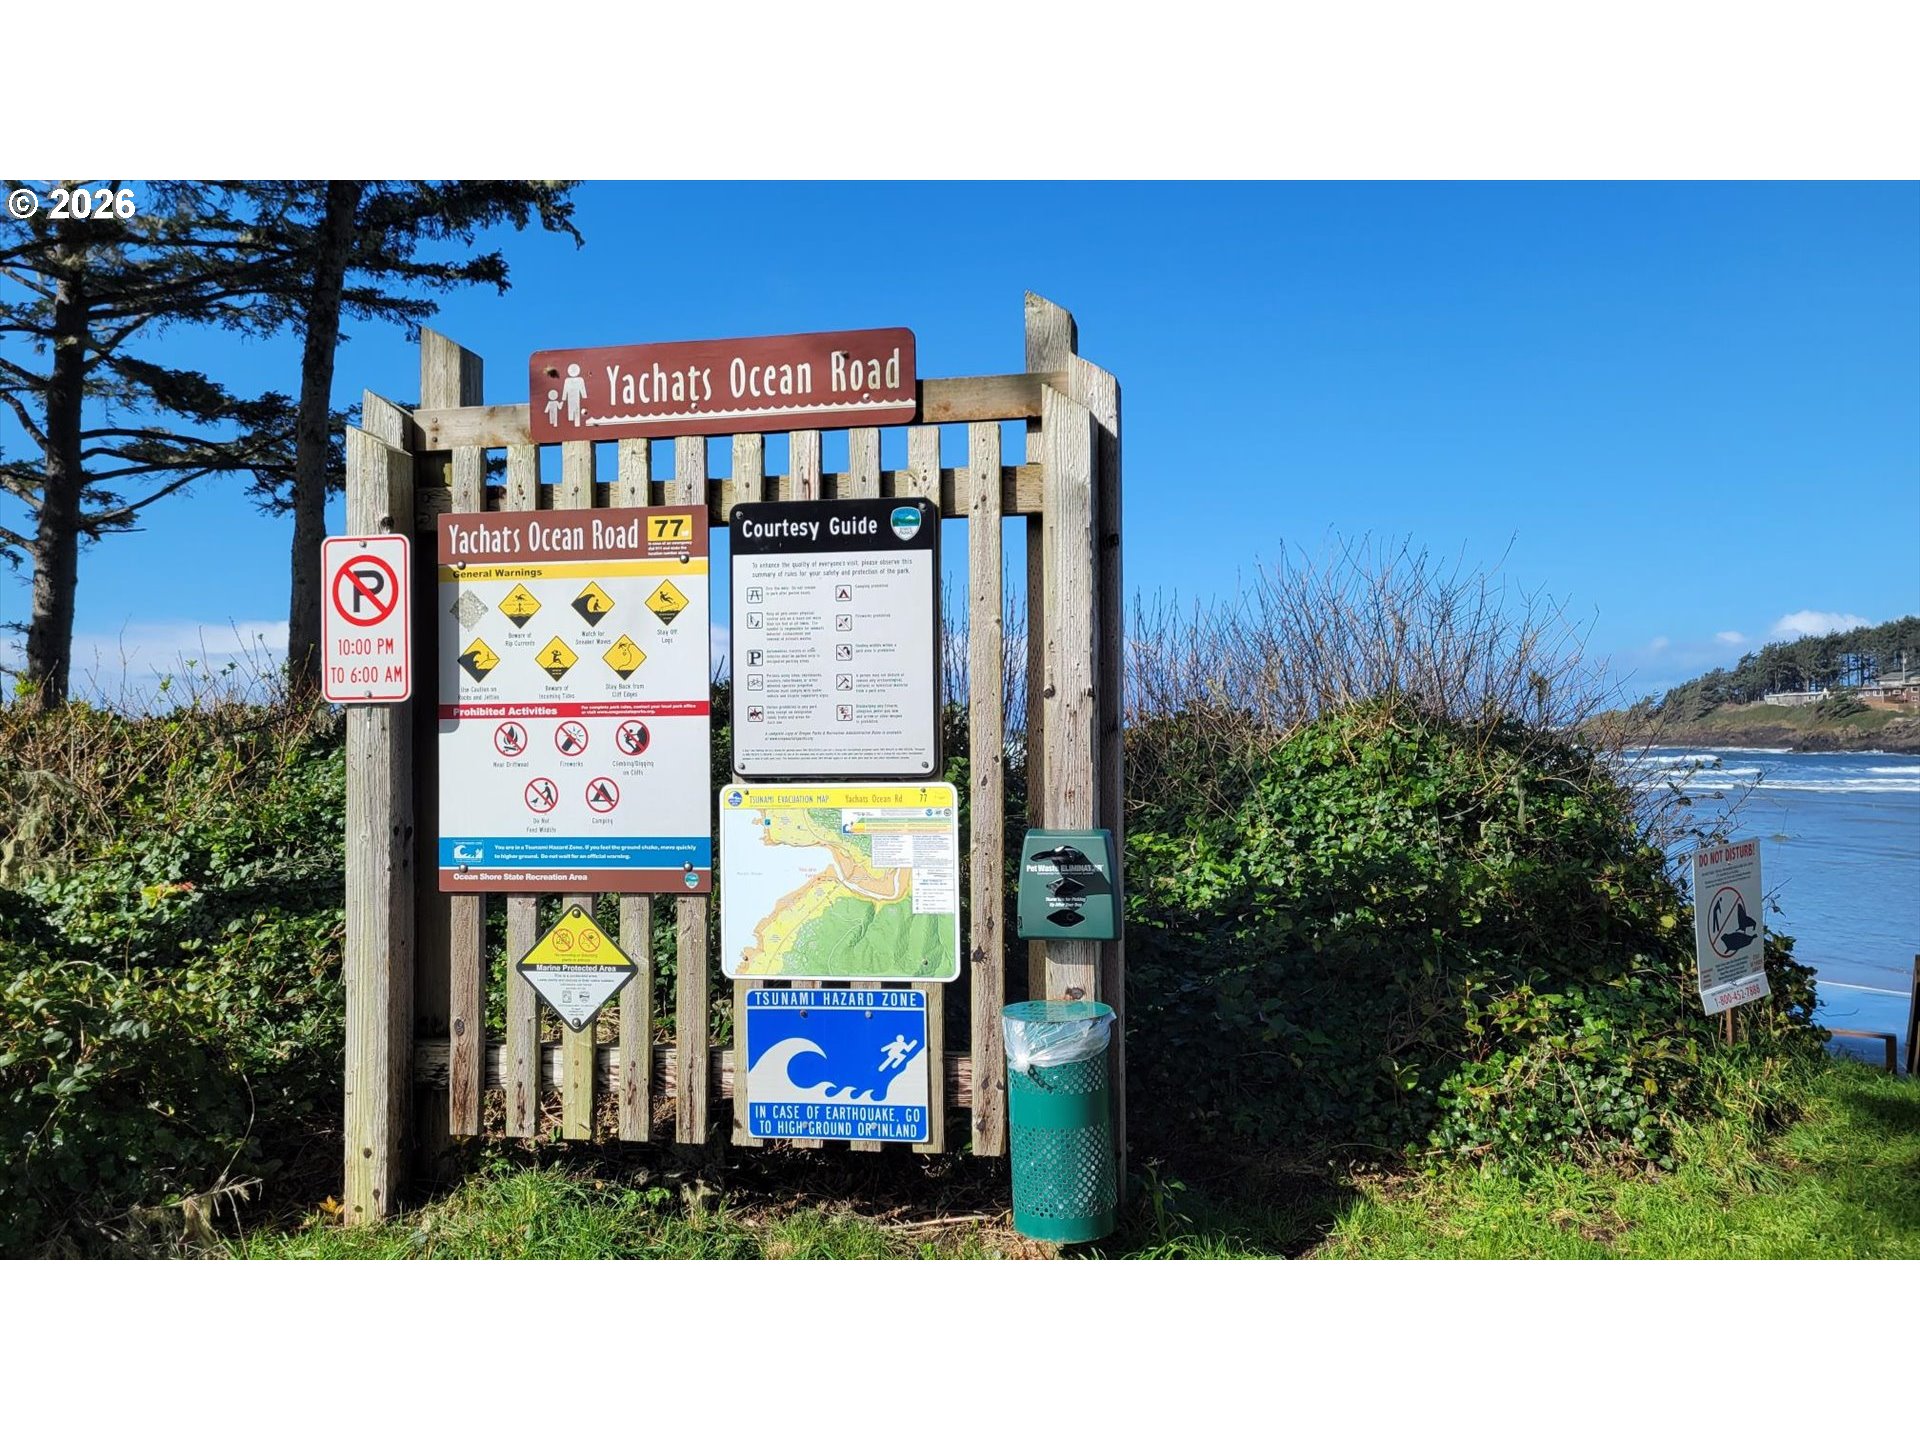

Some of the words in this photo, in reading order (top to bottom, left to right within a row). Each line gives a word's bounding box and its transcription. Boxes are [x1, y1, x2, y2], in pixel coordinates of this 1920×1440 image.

[606, 362, 713, 406] Yachats
[729, 357, 812, 399] Ocean
[830, 348, 901, 392] Road
[653, 519, 684, 538] 77
[742, 519, 820, 541] Courtesy
[829, 516, 878, 535] Guide
[448, 521, 520, 555] Yachats
[528, 521, 584, 552] Ocean
[591, 518, 639, 550] Road
[792, 561, 809, 569] quality
[861, 559, 878, 567] please
[452, 569, 492, 579] General
[495, 568, 543, 578] Warnings
[752, 571, 776, 579] summary
[851, 569, 878, 577] protection
[656, 629, 669, 637] Stay
[338, 638, 371, 656] 10:00
[377, 638, 394, 655] PM
[331, 666, 345, 683] TO
[350, 666, 378, 683] 6:00
[385, 666, 402, 682] AM
[453, 707, 505, 716] Prohibited
[508, 706, 558, 715] Activities
[559, 760, 584, 768] Fireworks
[749, 795, 774, 804] TSUNAMI
[777, 795, 813, 804] EVACUATION
[816, 794, 829, 803] MAP
[844, 795, 869, 804] Yachats
[871, 794, 892, 803] Ocean
[895, 794, 903, 803] Rd
[919, 793, 928, 803] 77
[591, 817, 613, 825] Camping
[1698, 853, 1709, 868] DO
[1710, 850, 1723, 865] NOT
[1725, 843, 1755, 861] DISTURB!
[1038, 864, 1059, 872] Waste
[453, 873, 478, 881] Ocean
[480, 873, 502, 881] Shore
[503, 873, 524, 881] State
[525, 873, 567, 881] Recreation
[569, 873, 588, 881] Area
[755, 992, 815, 1006] TSUNAMI
[823, 992, 874, 1006] HAZARD
[882, 993, 917, 1007] ZONE
[755, 1105, 766, 1118] IN
[772, 1105, 800, 1119] CASE
[806, 1106, 820, 1119] OF
[905, 1108, 920, 1123] GO
[759, 1121, 771, 1134] TO
[777, 1121, 806, 1134] HIGH
[808, 1121, 851, 1136] GROUND
[857, 1122, 872, 1136] OR
[877, 1123, 917, 1138] INLAND
